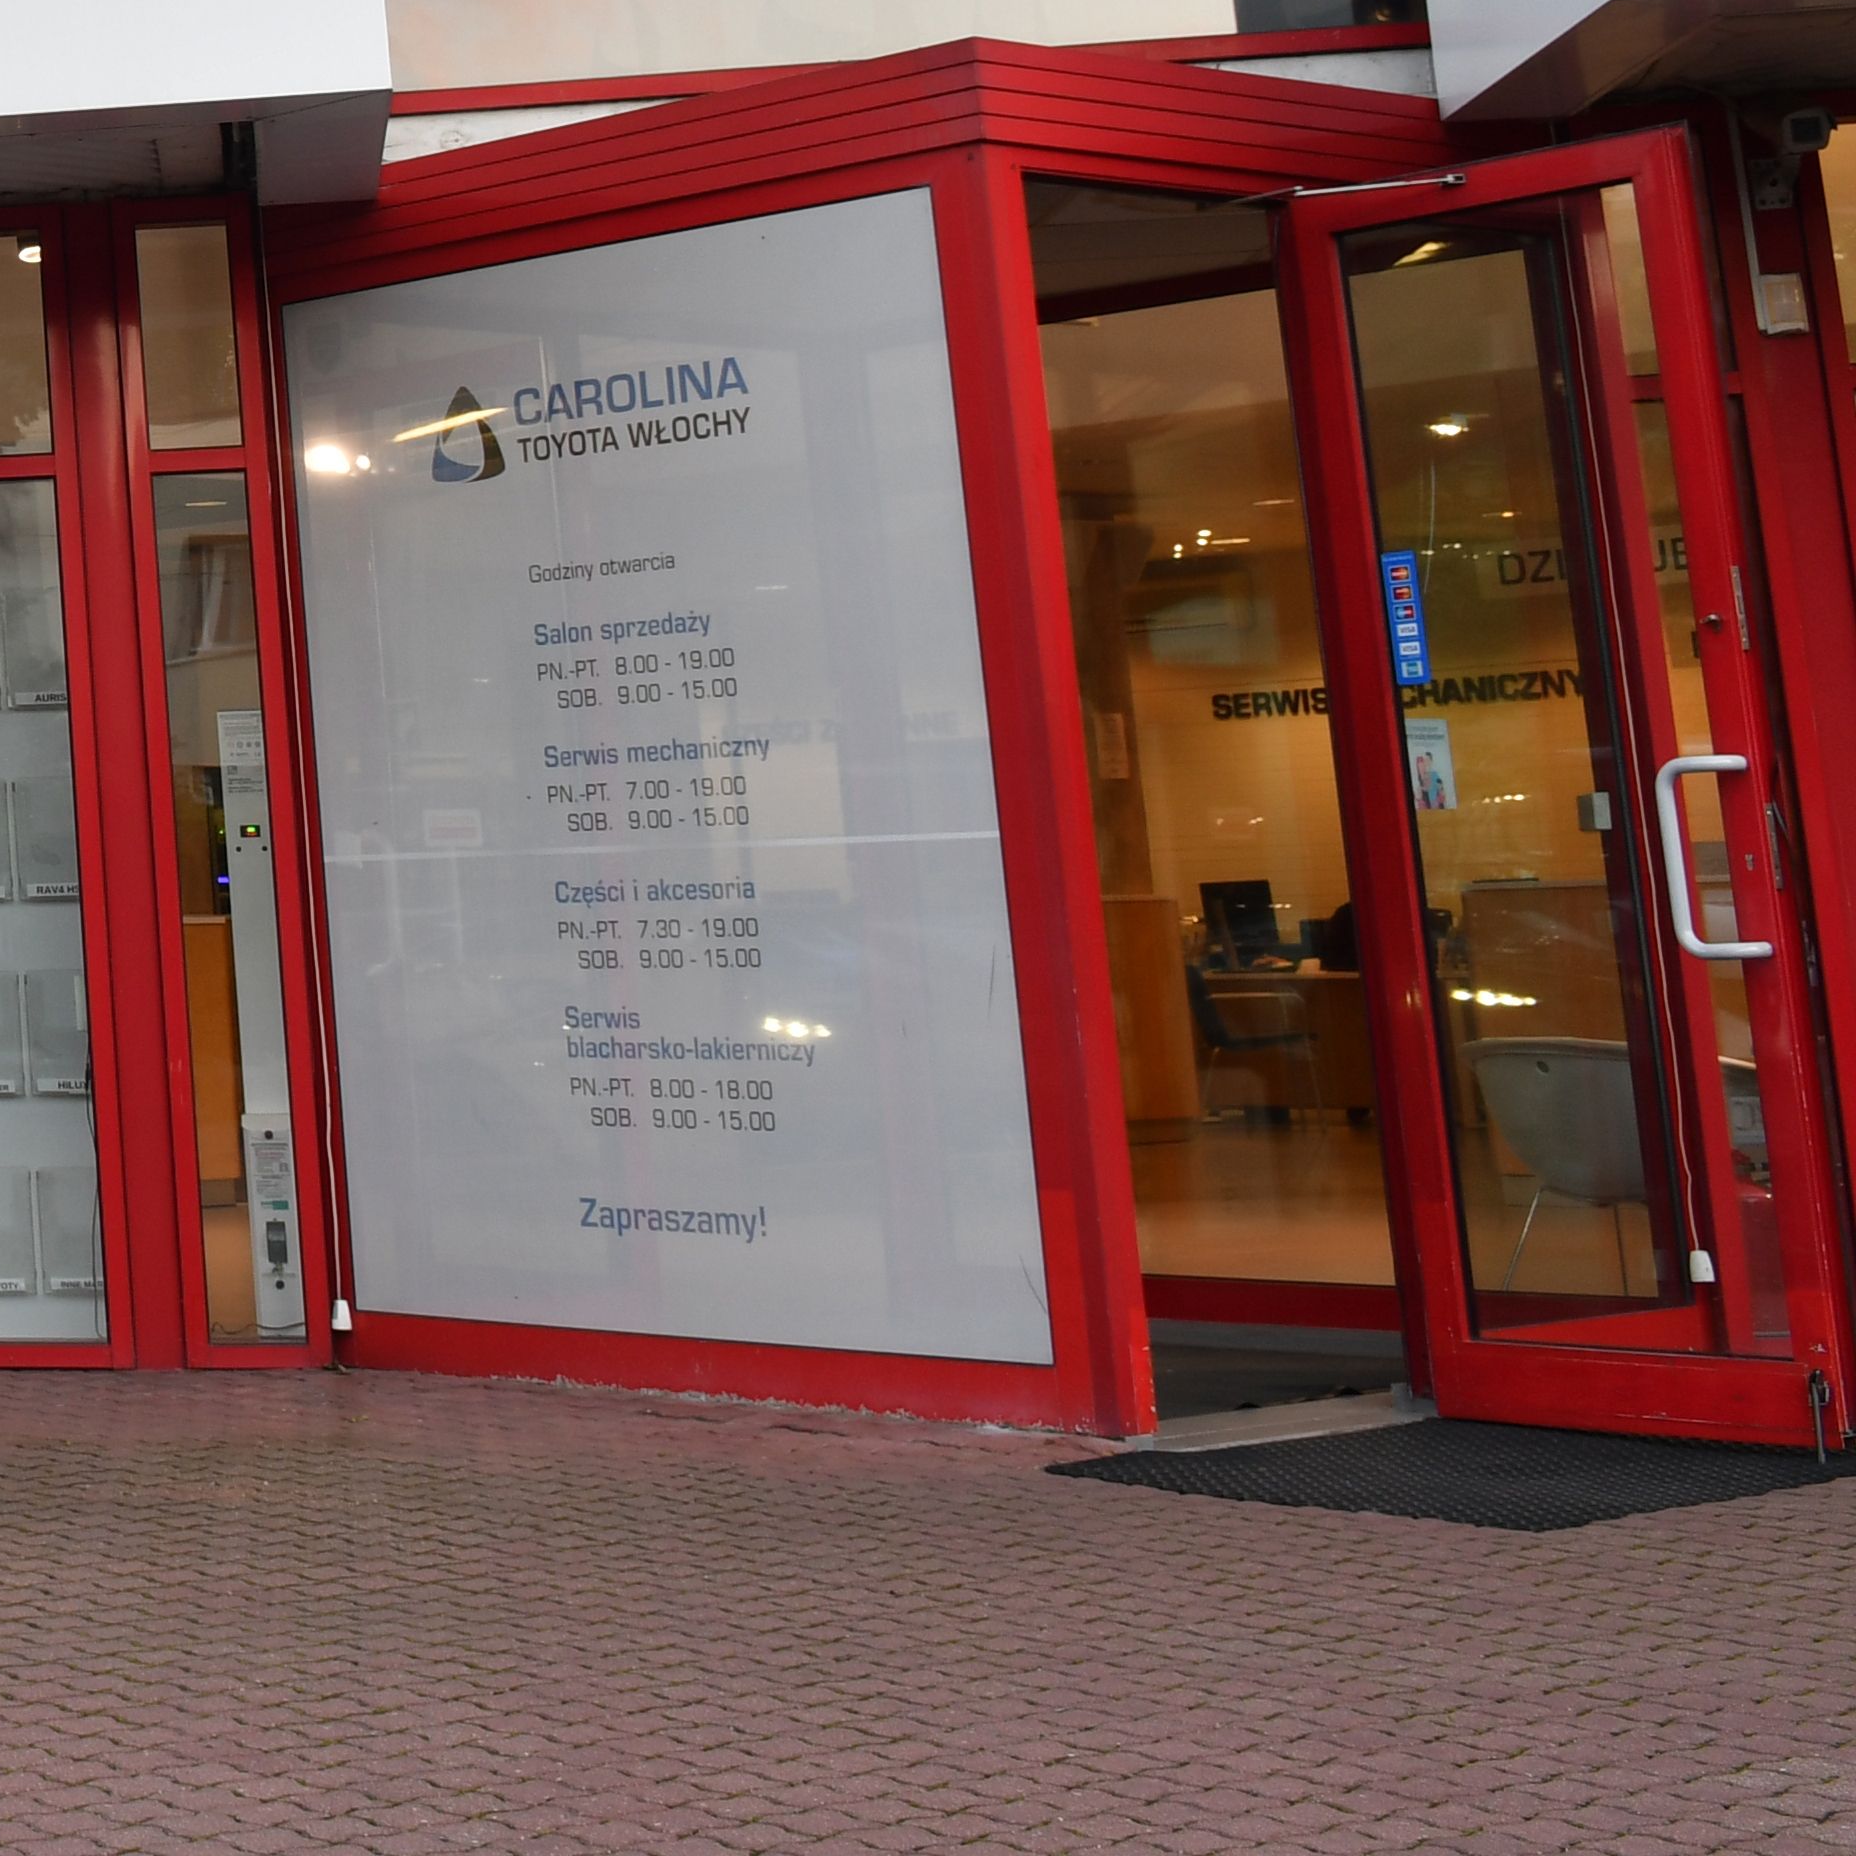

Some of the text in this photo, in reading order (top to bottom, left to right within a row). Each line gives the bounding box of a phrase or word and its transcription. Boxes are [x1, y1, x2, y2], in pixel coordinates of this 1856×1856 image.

[513, 356, 750, 427] CAROLINA
[517, 407, 751, 463] TOYOTA WŁOCHY
[528, 552, 676, 584] Godziny otwarcia
[534, 610, 711, 647] Salon sprzedaży
[537, 658, 600, 682] PN.-PT.
[615, 654, 659, 676] 8.00
[678, 647, 735, 671] 19.00
[35, 694, 67, 702] AURIS
[557, 688, 603, 709] SOB.
[617, 683, 661, 705] 9.00
[681, 677, 738, 700] 15.00
[1212, 669, 1584, 721] SERWIS CHANICZNY
[543, 736, 770, 768] Serwis mechaniczny
[547, 781, 611, 804] PN.-PT.
[625, 779, 670, 801] 7.00
[688, 776, 747, 798] 19.00
[567, 812, 613, 832] SOB.
[628, 808, 672, 830] 9.00
[692, 805, 750, 828] 15.00
[36, 885, 64, 894] RAV4
[555, 876, 756, 909] Części i akcesoria
[557, 920, 622, 940] PN.-PT.
[636, 918, 681, 939] 7.30
[701, 916, 759, 938] 19.00
[578, 950, 624, 970] SOB.
[639, 949, 683, 969] 9.00
[703, 948, 761, 969] 15.00
[564, 1005, 641, 1029] Serwis
[566, 1036, 816, 1067] blacharsko-lakierniczy
[570, 1078, 634, 1098] PN.-PT.
[650, 1078, 694, 1098] 8.00
[714, 1079, 772, 1101] 18.00
[590, 1108, 637, 1127] SOB.
[652, 1109, 697, 1130] 9.00
[717, 1111, 776, 1132] 15.00
[578, 1196, 767, 1244] Zapraszamy!
